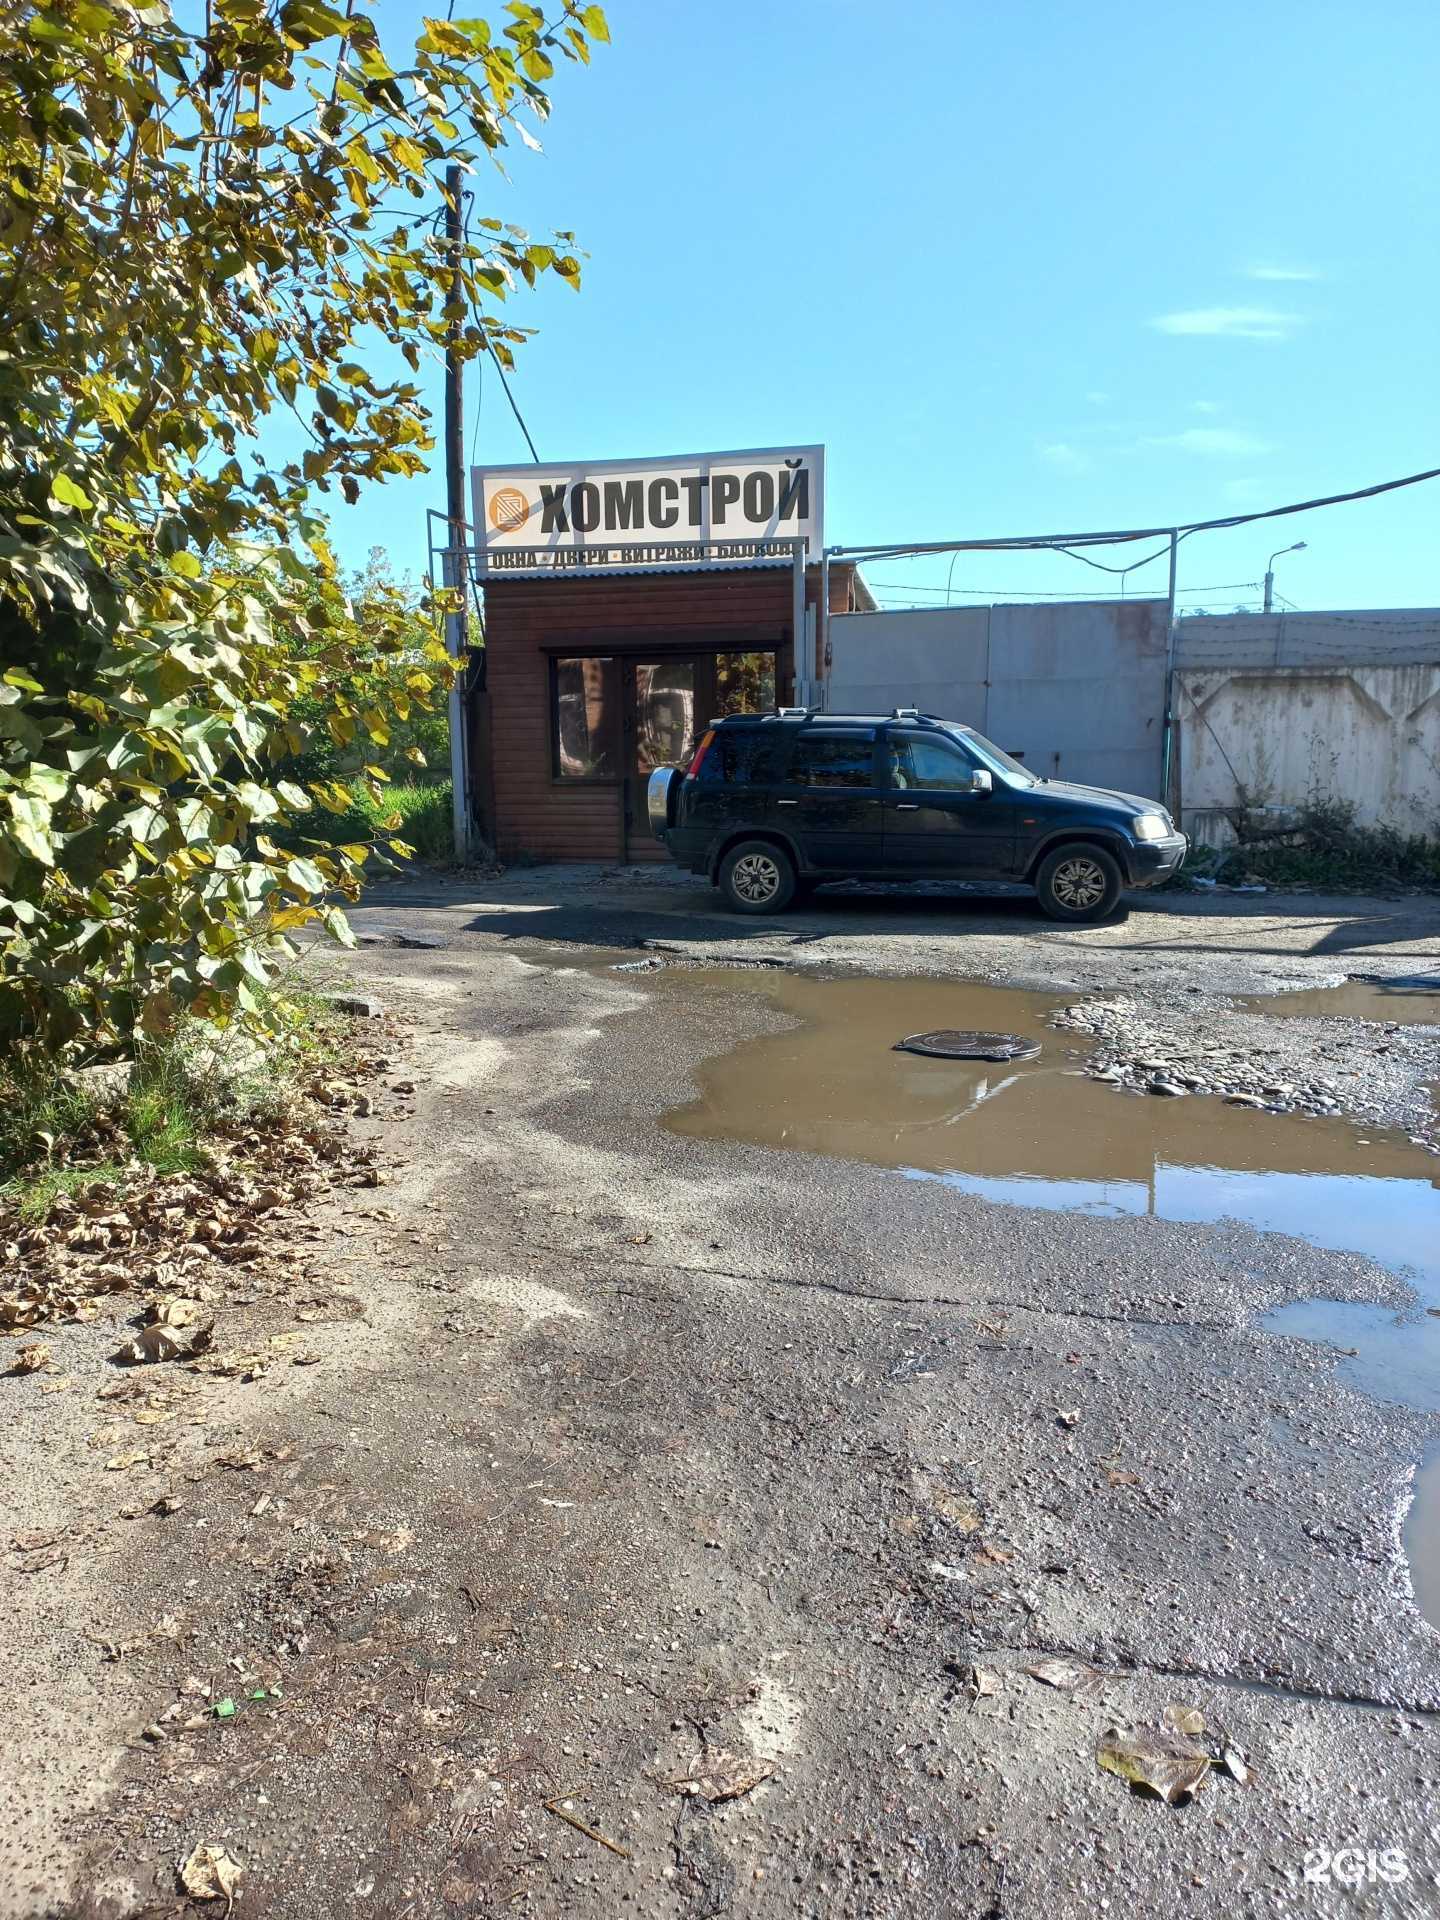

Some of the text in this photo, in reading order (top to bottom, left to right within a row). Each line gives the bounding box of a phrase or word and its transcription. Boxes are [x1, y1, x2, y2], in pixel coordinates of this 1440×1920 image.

[539, 458, 809, 534] ХОМСТРОЙ
[492, 550, 538, 569] ОКНА
[553, 549, 609, 570] ДВЕРИ
[621, 545, 705, 564] ВИТРАЖИ
